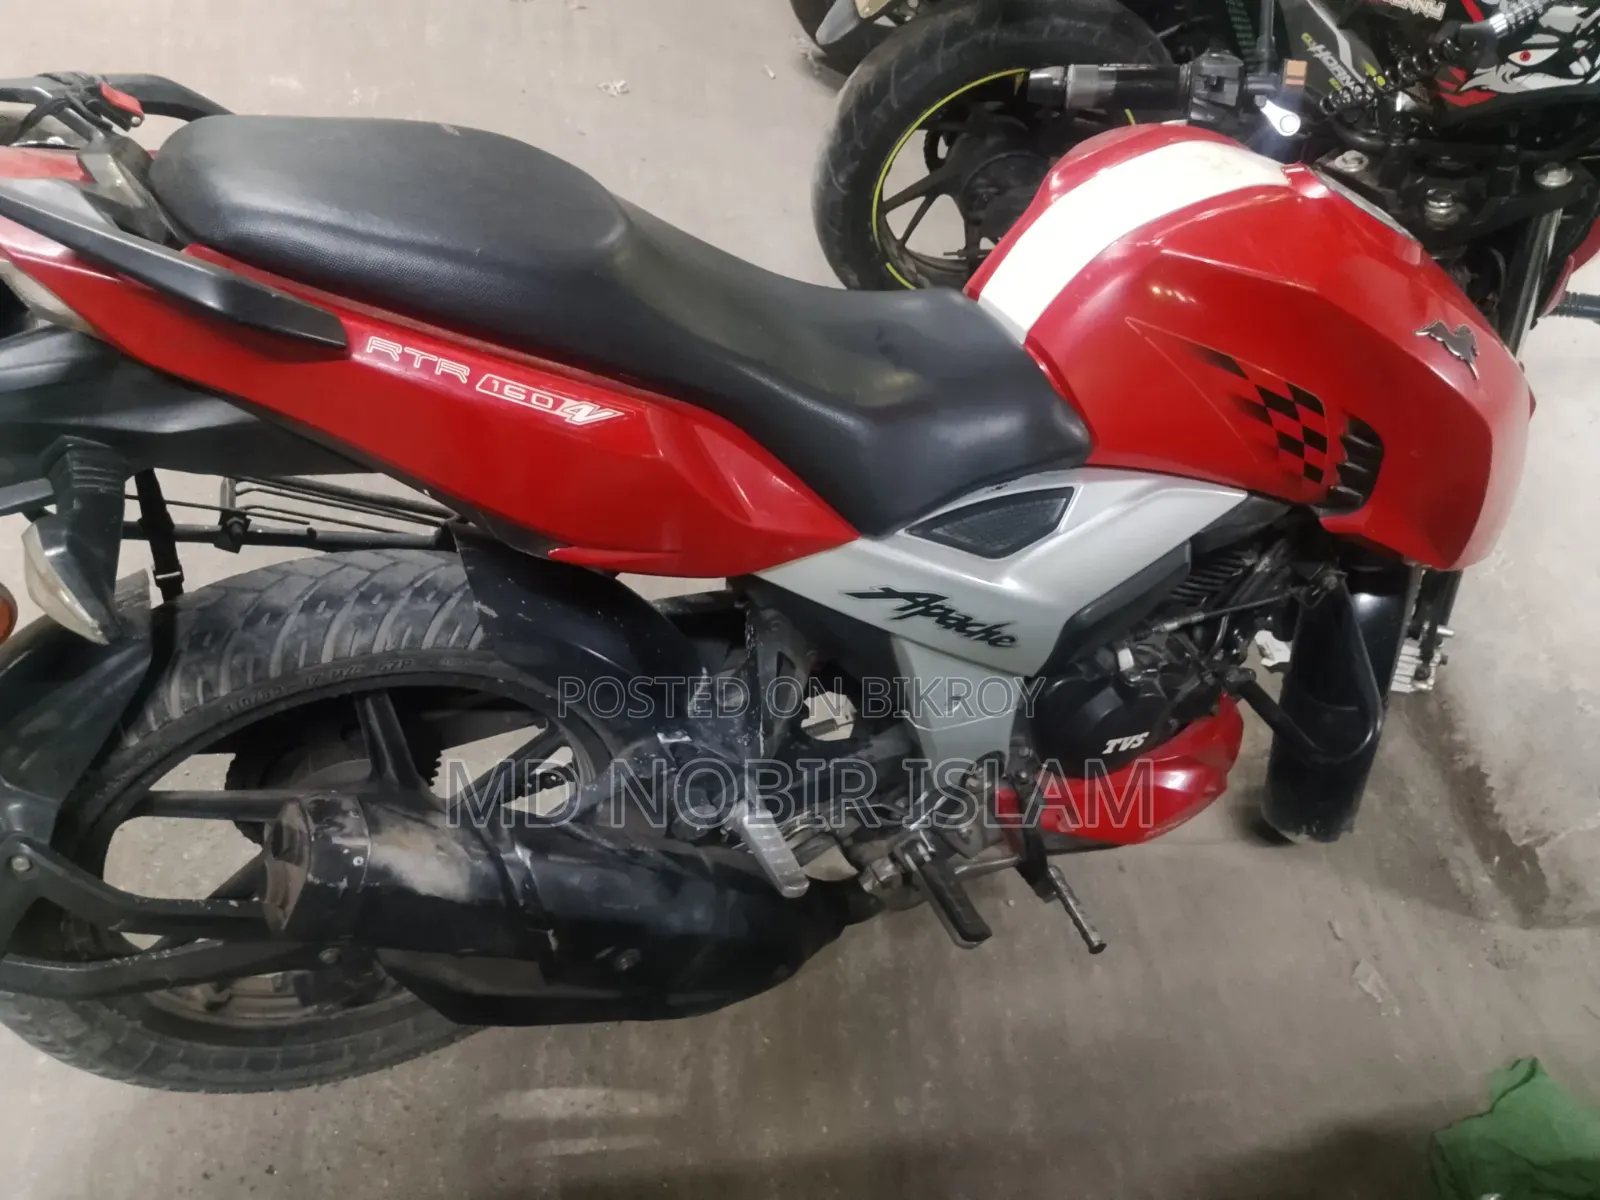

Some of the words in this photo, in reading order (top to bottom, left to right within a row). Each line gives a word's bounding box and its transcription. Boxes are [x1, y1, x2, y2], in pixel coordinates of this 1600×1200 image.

[366, 336, 470, 383] RTR
[841, 586, 1018, 648] Apache
[1102, 731, 1149, 755] TVS
